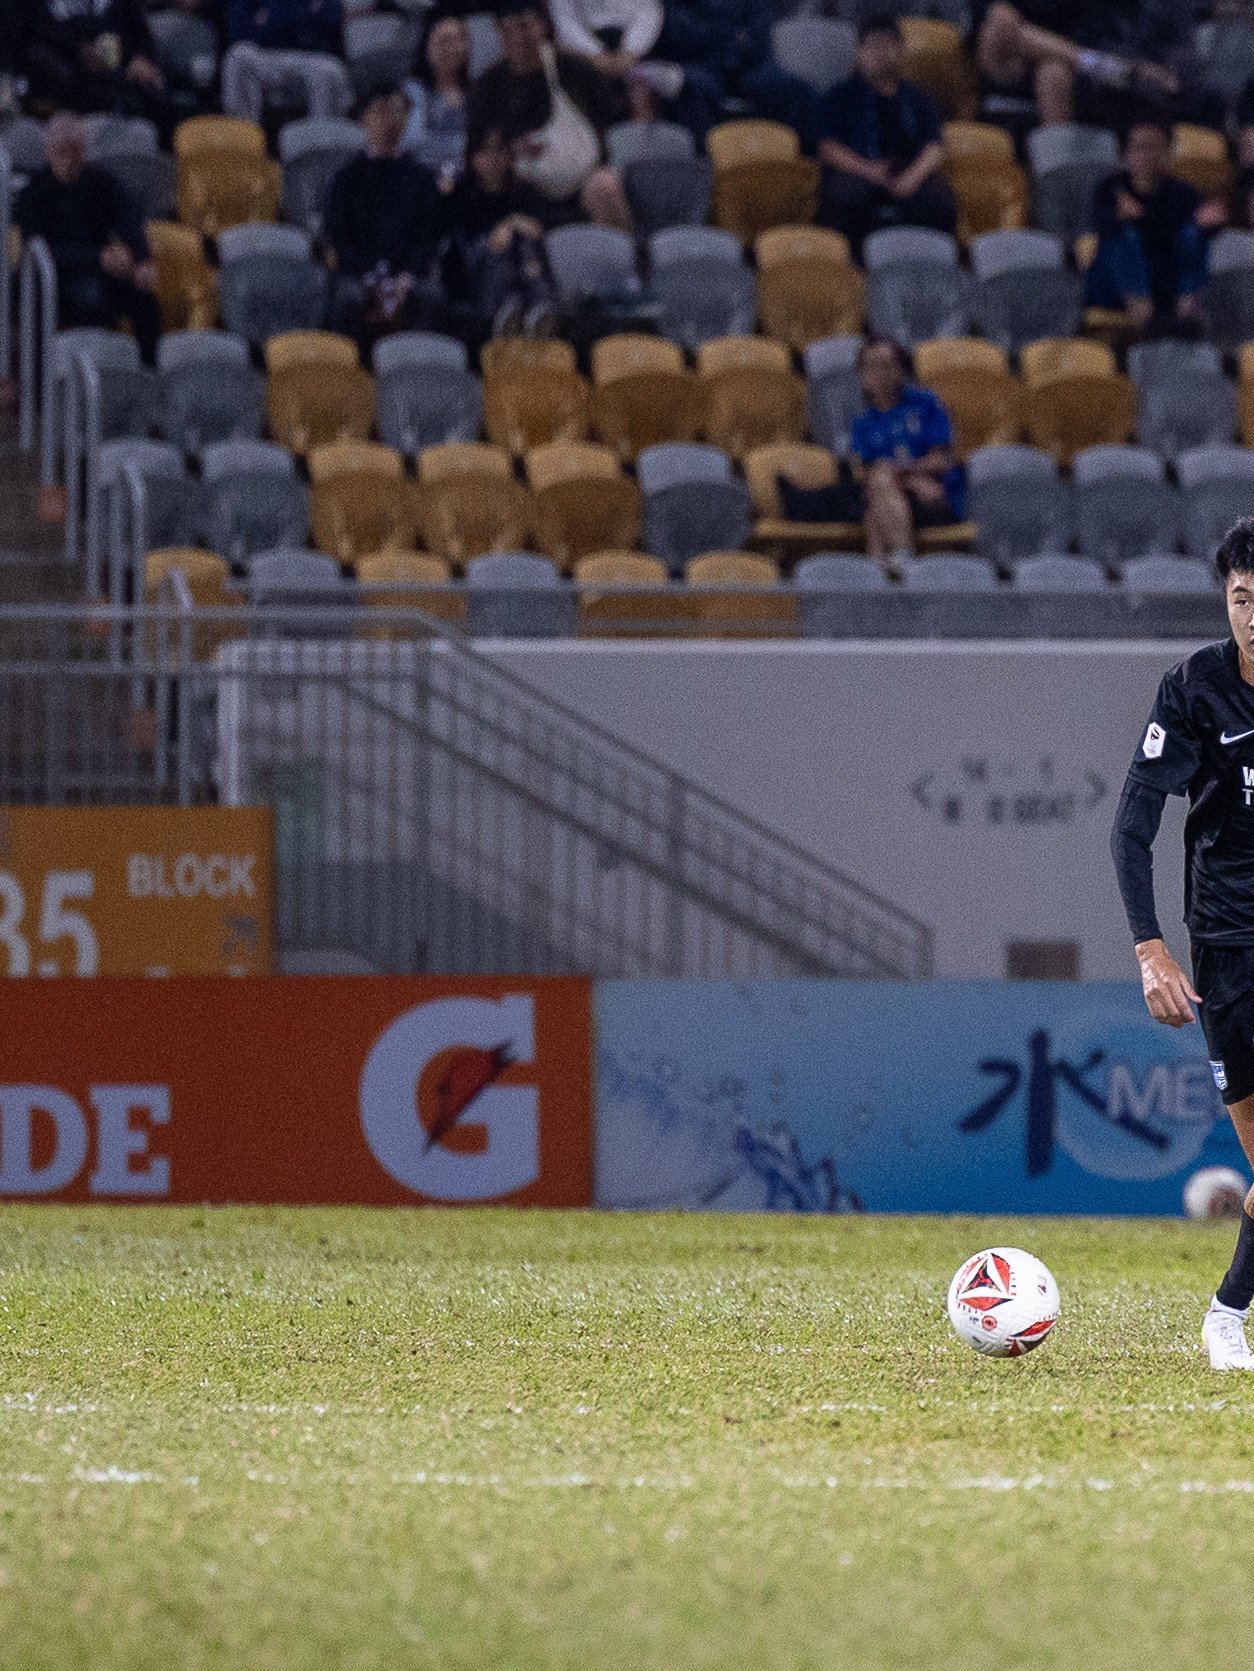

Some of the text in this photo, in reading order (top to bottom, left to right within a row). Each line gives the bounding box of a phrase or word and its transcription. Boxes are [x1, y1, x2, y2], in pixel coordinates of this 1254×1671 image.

[127, 852, 257, 898] BLOCK
[358, 992, 541, 1201] G
[1105, 1063, 1226, 1121] ME
[0, 1083, 171, 1195] DE
